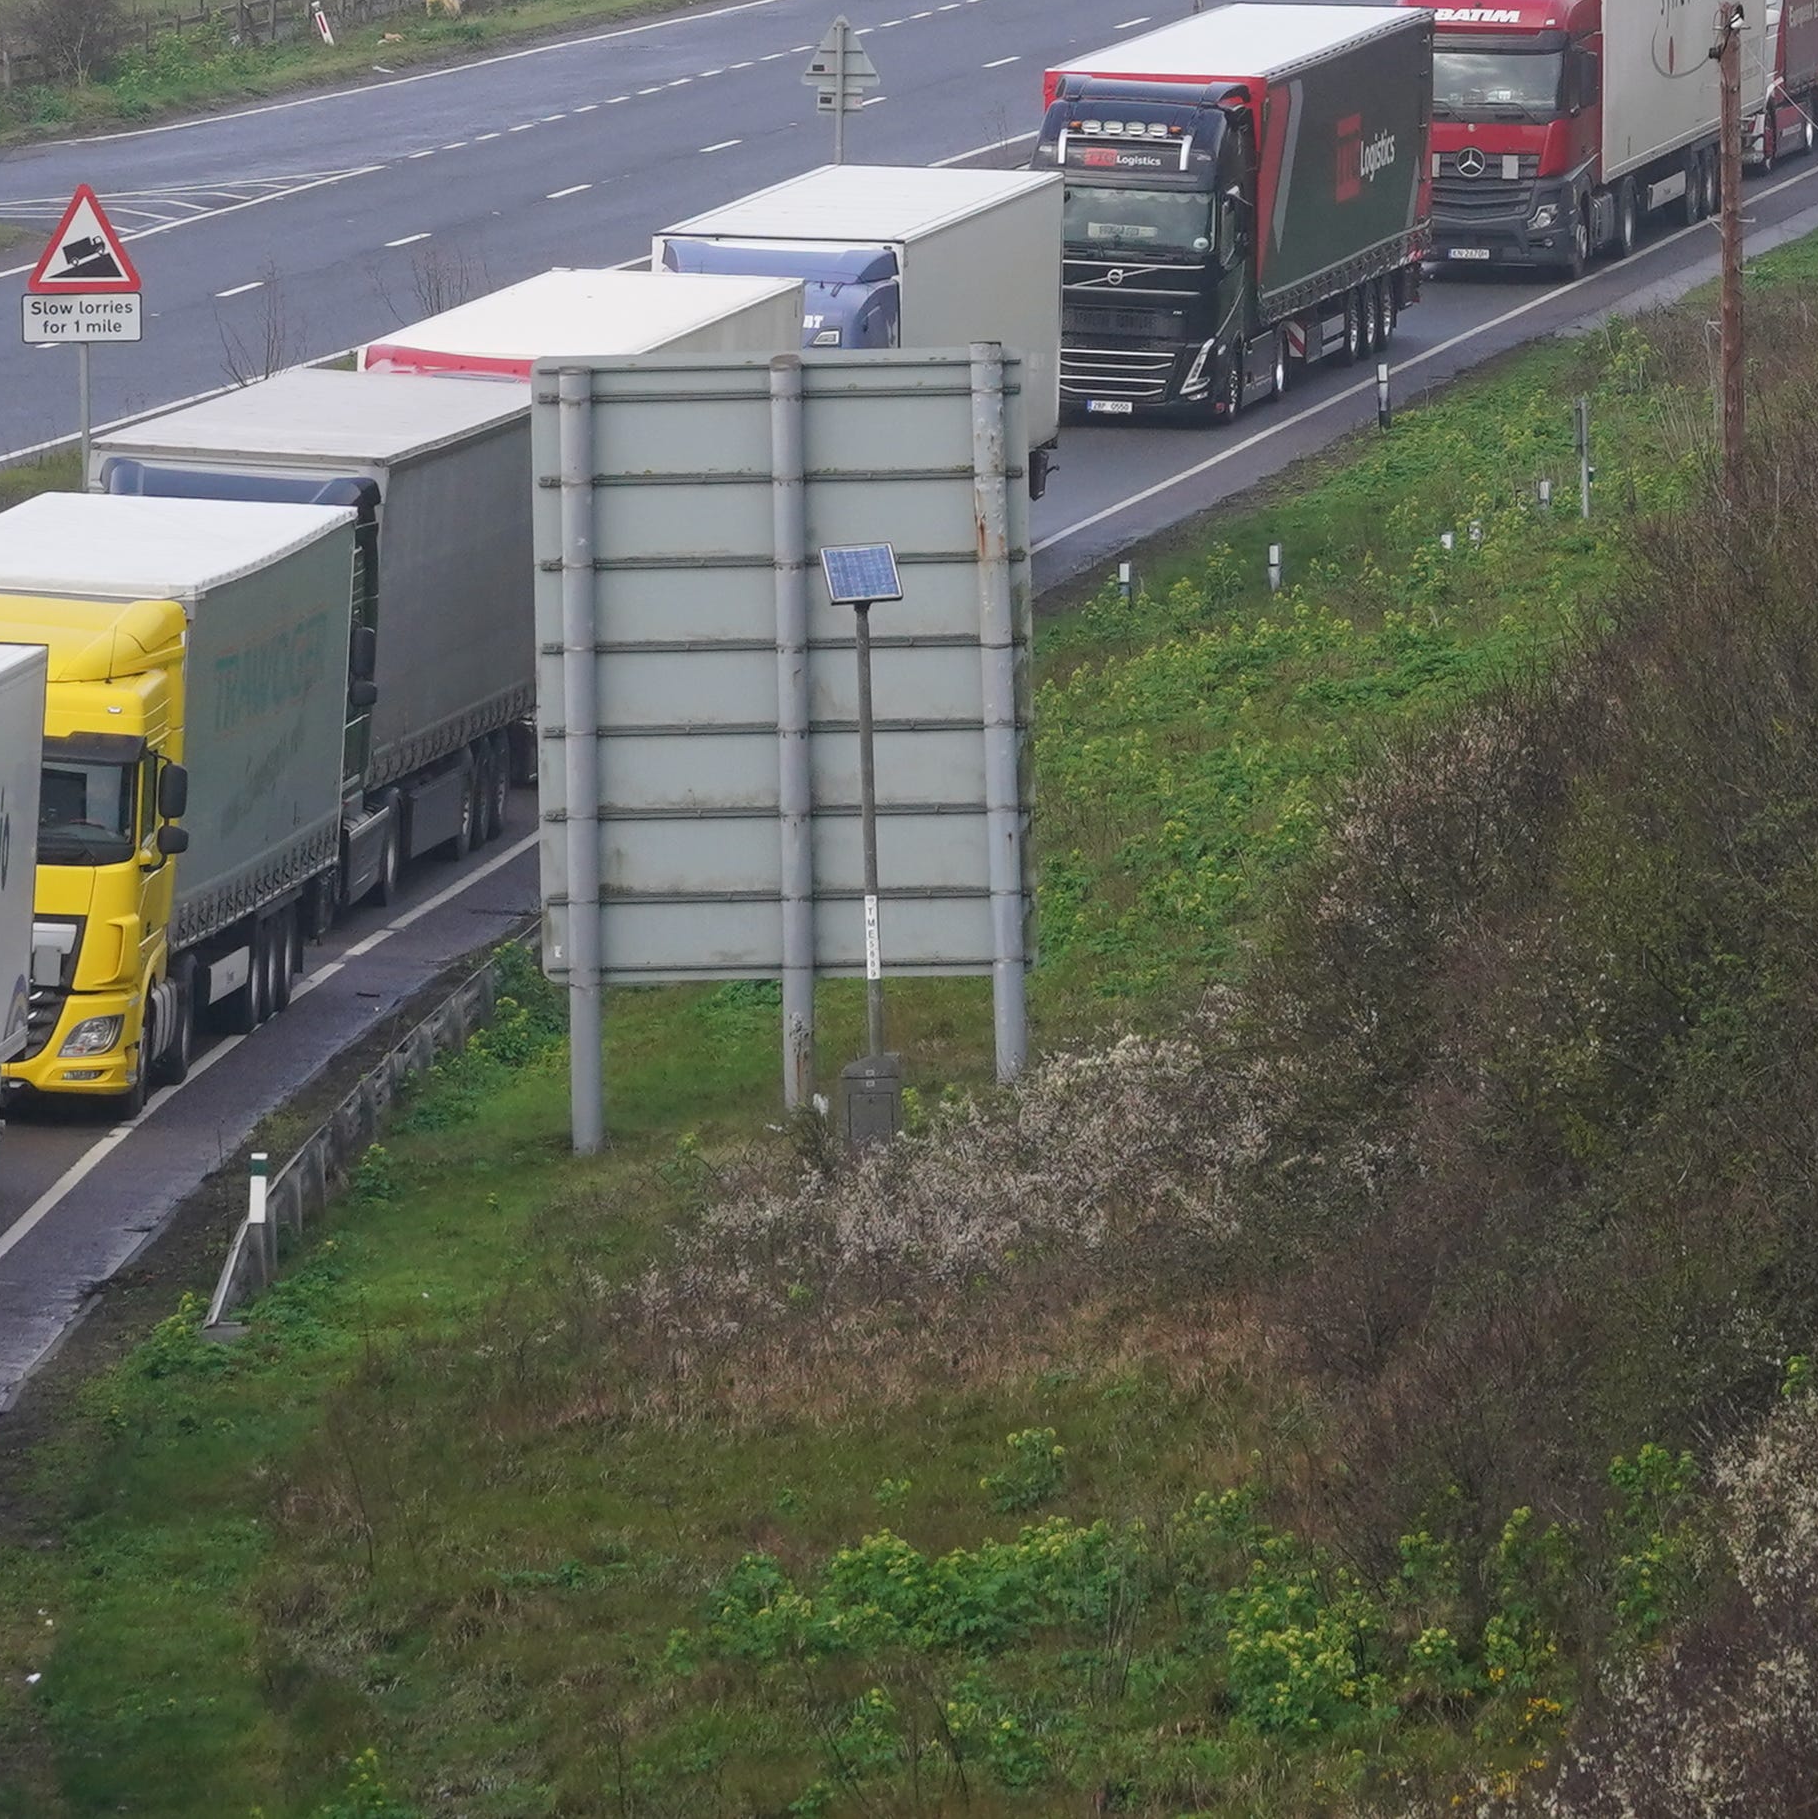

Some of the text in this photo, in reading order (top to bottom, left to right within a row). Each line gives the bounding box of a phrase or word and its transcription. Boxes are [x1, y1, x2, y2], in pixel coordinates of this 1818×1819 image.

[1434, 8, 1520, 23] BATIM
[1116, 155, 1162, 167] Logistics
[1360, 128, 1395, 182] Logistics
[31, 300, 133, 315] Slow lorries
[43, 319, 122, 333] for 1 mile
